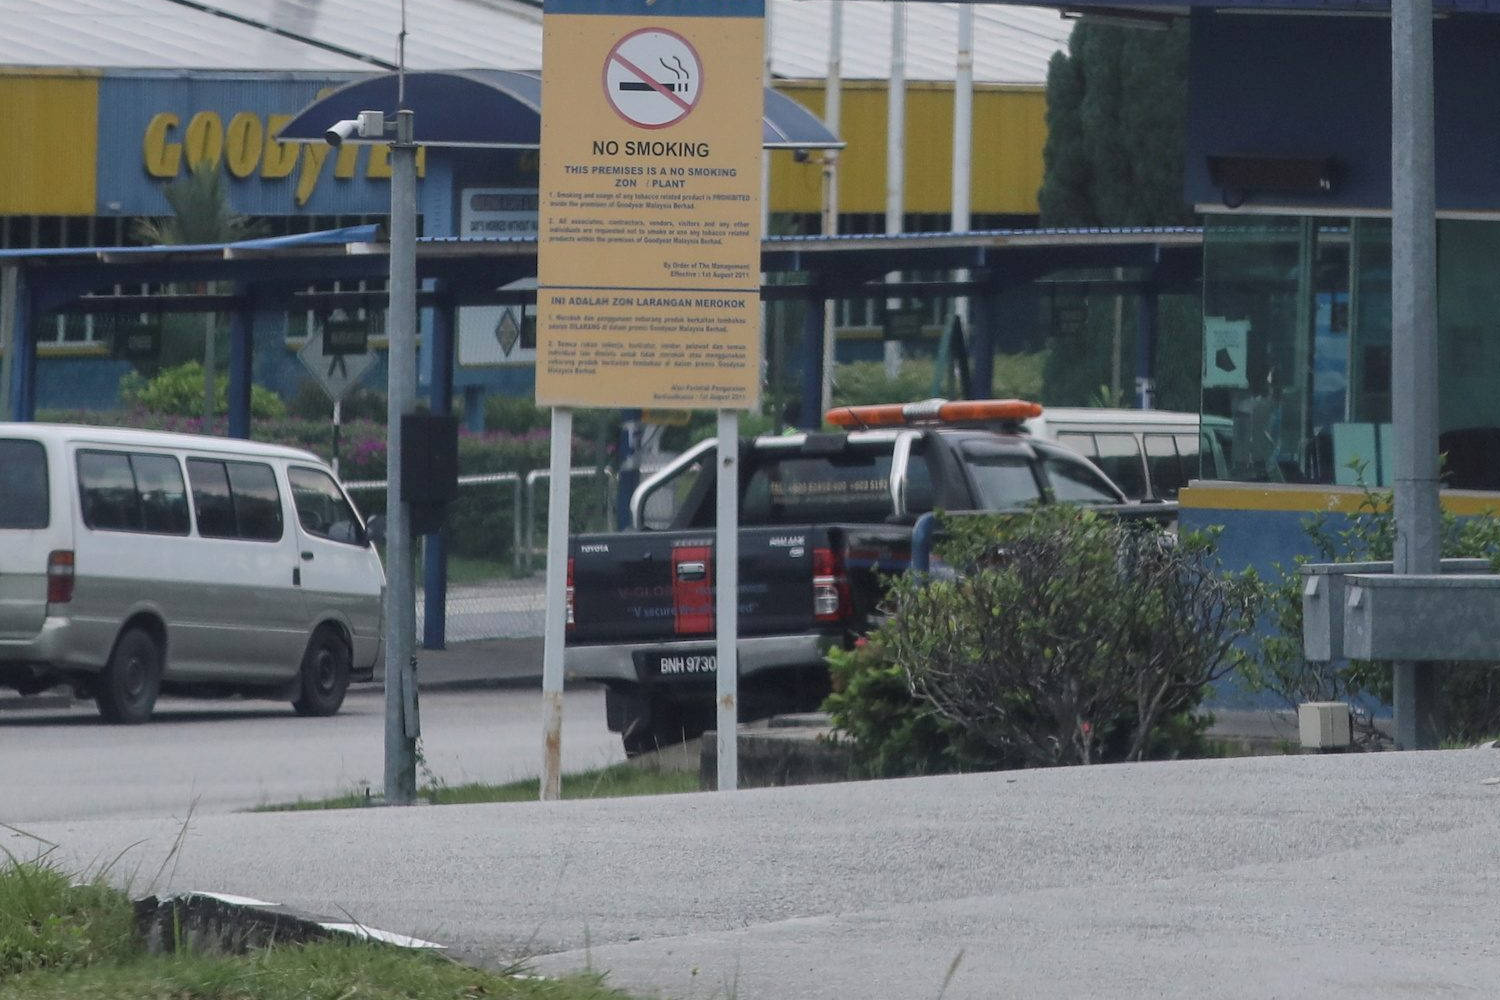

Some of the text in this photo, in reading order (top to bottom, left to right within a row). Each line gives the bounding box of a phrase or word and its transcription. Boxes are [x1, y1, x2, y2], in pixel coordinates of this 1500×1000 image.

[593, 140, 710, 158] NO SMOKING
[565, 165, 588, 174] THIS
[592, 166, 643, 175] PREMISES
[647, 167, 657, 175] IS
[670, 168, 685, 176] NO
[688, 168, 737, 176] SMOKING
[652, 179, 685, 188] PLANT
[551, 297, 745, 309] INI ADALAH ZON LARANGAN MEROKOK
[581, 544, 609, 553] TOYOTA
[660, 655, 716, 674] BNH 9730
